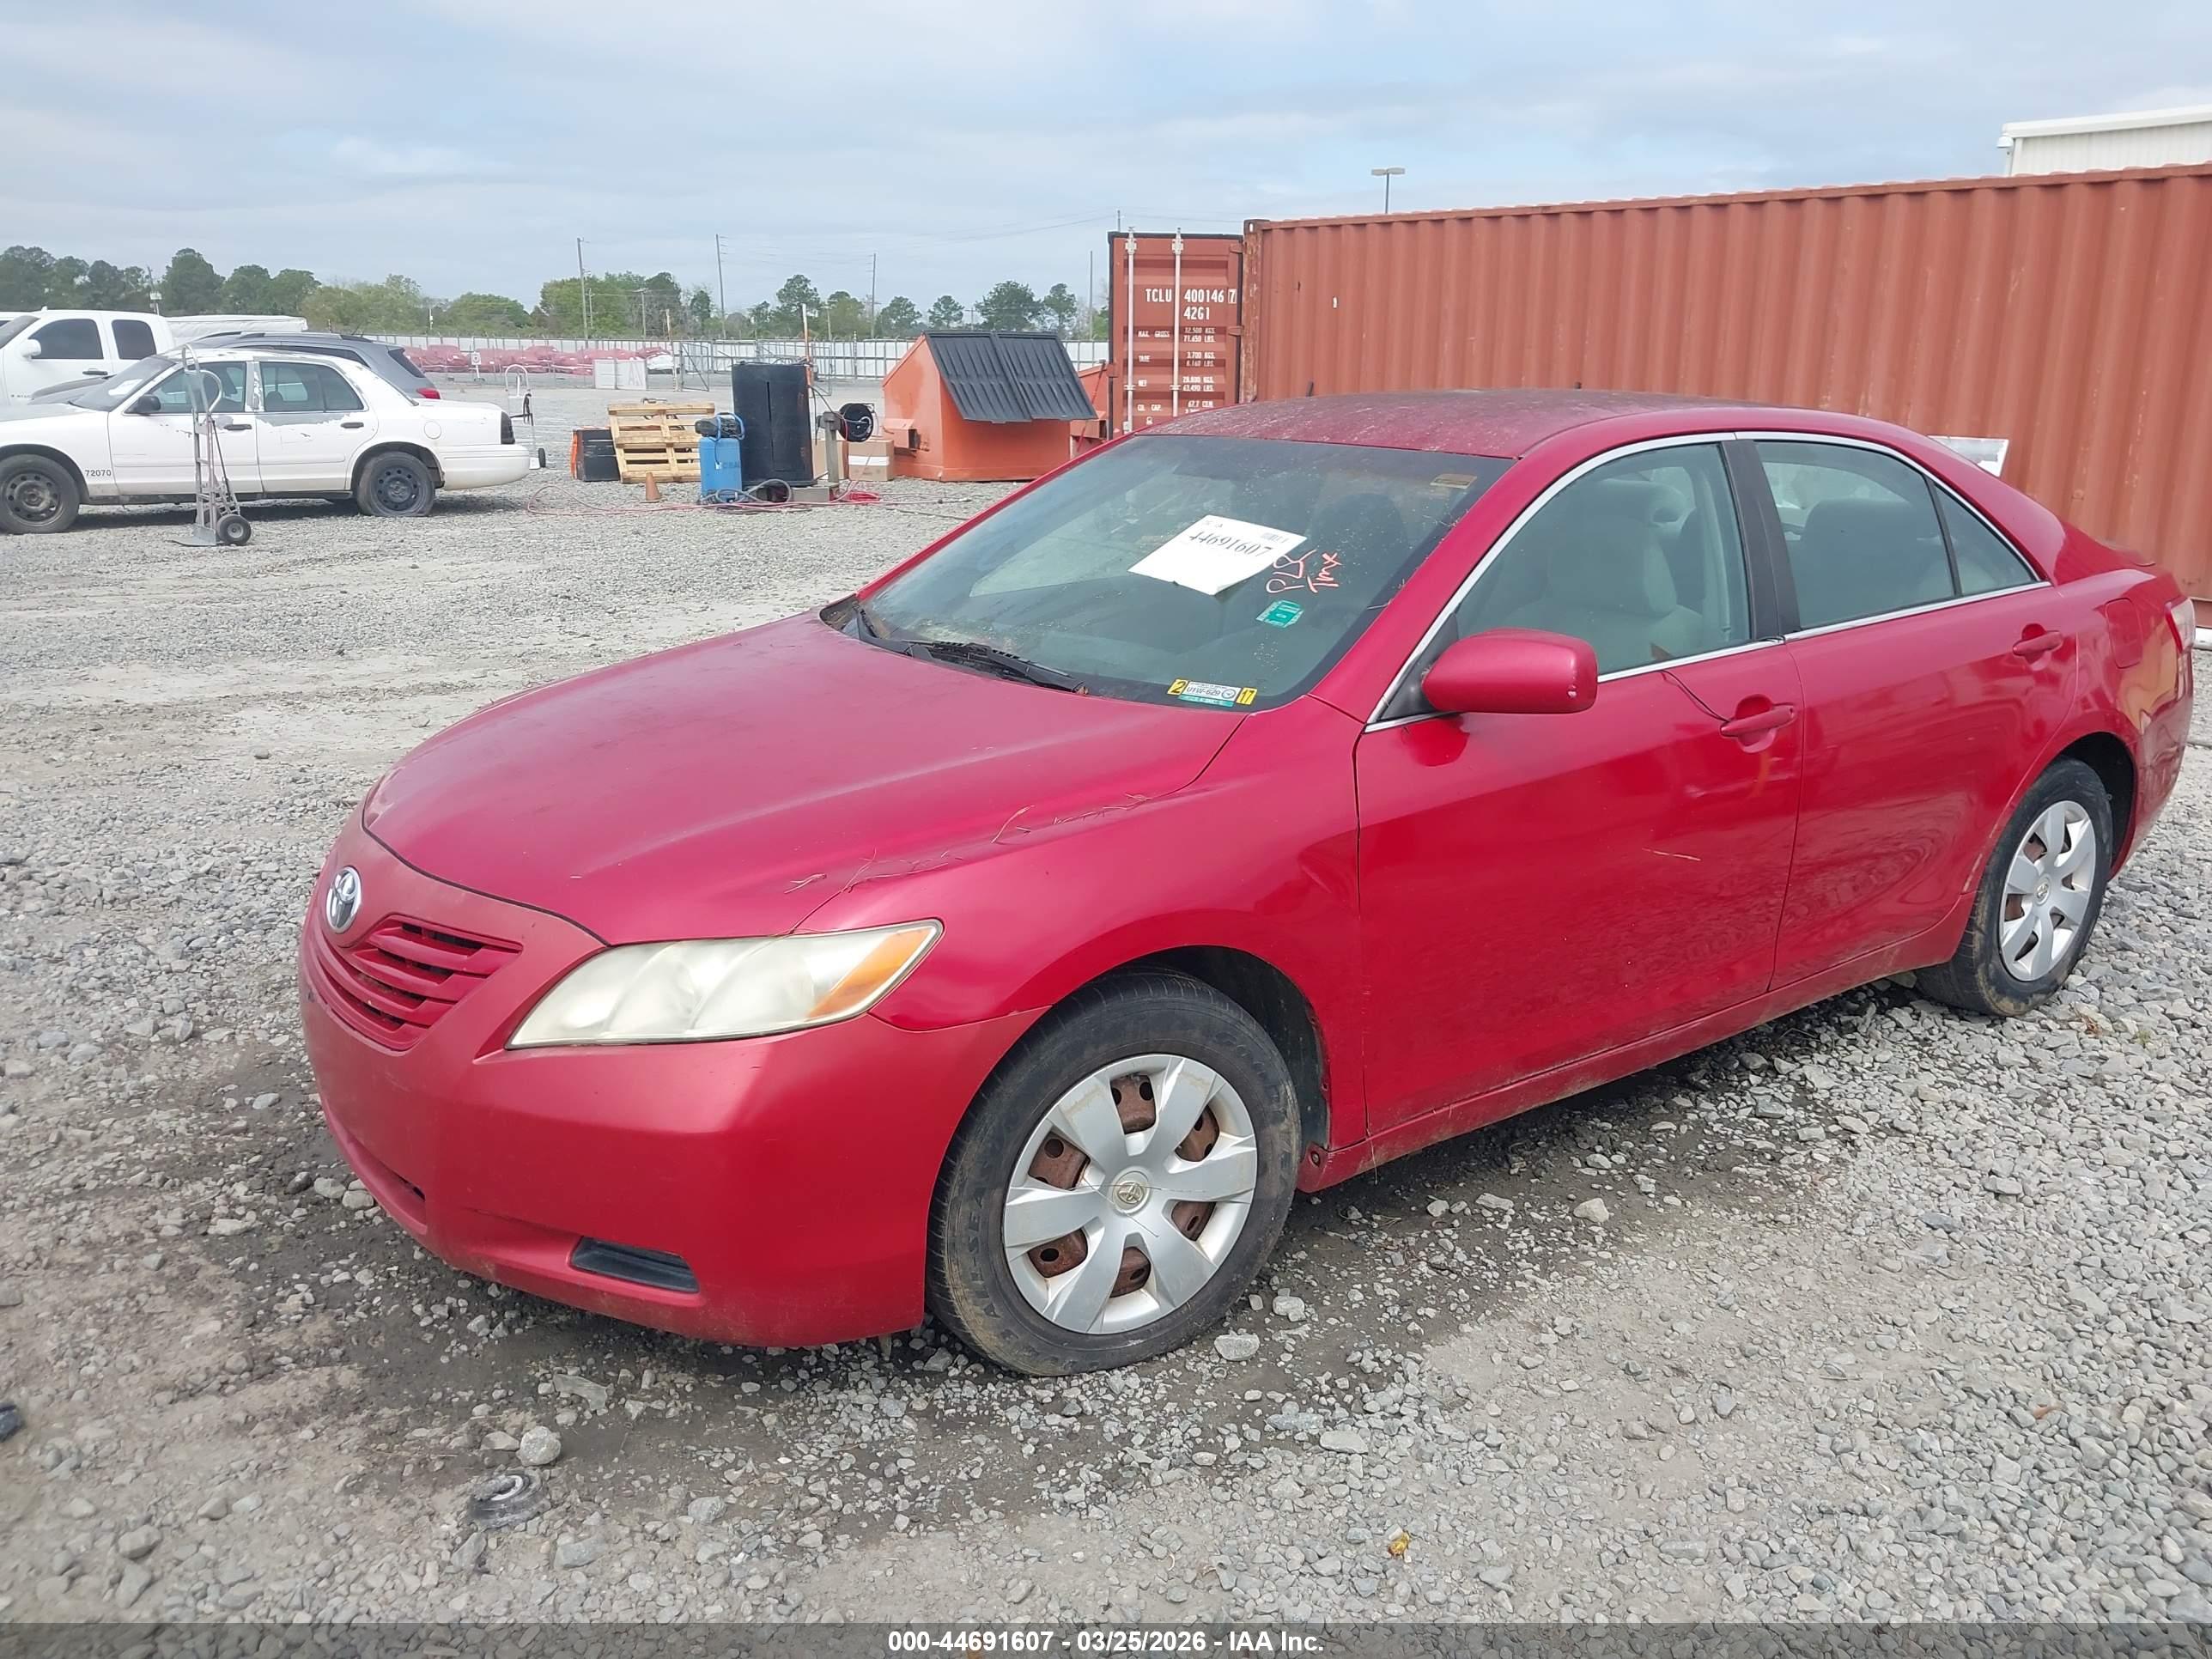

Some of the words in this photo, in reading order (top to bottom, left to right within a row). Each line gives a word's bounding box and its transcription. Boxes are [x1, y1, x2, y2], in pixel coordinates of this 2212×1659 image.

[1145, 288, 1172, 302] TCLU
[1184, 289, 1224, 303] 400146
[1228, 289, 1237, 304] 7
[1183, 306, 1210, 320] 42G1
[1188, 531, 1273, 557] 44691607
[1170, 680, 1186, 694] 2
